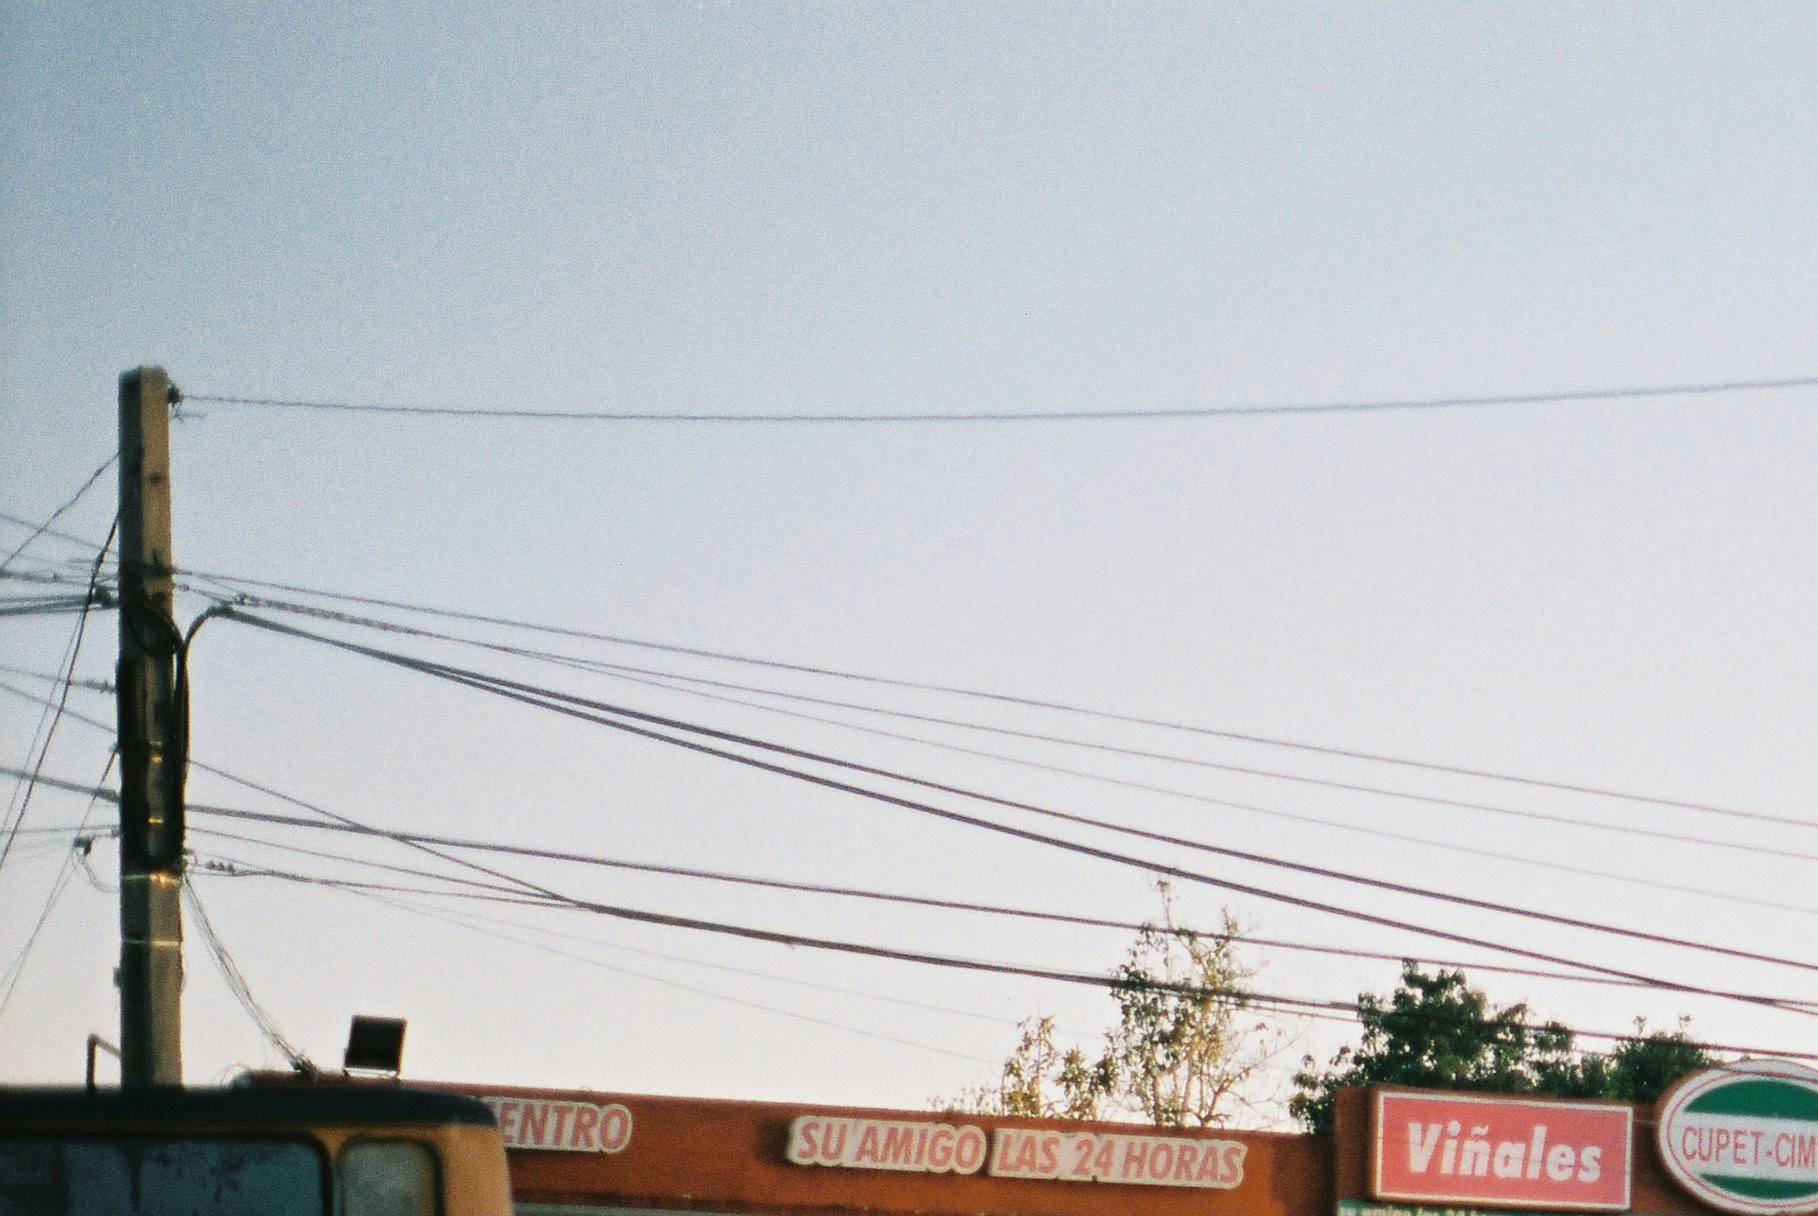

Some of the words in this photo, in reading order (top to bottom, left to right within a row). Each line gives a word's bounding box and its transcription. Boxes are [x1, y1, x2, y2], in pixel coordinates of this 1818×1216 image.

[490, 1100, 630, 1151] ENTRO
[799, 1122, 848, 1162] SU
[855, 1124, 982, 1170] AMIGO
[999, 1135, 1062, 1175] LAS
[1070, 1139, 1115, 1178] 24
[1122, 1141, 1242, 1184] HORAS
[1407, 1119, 1602, 1183] Viñales
